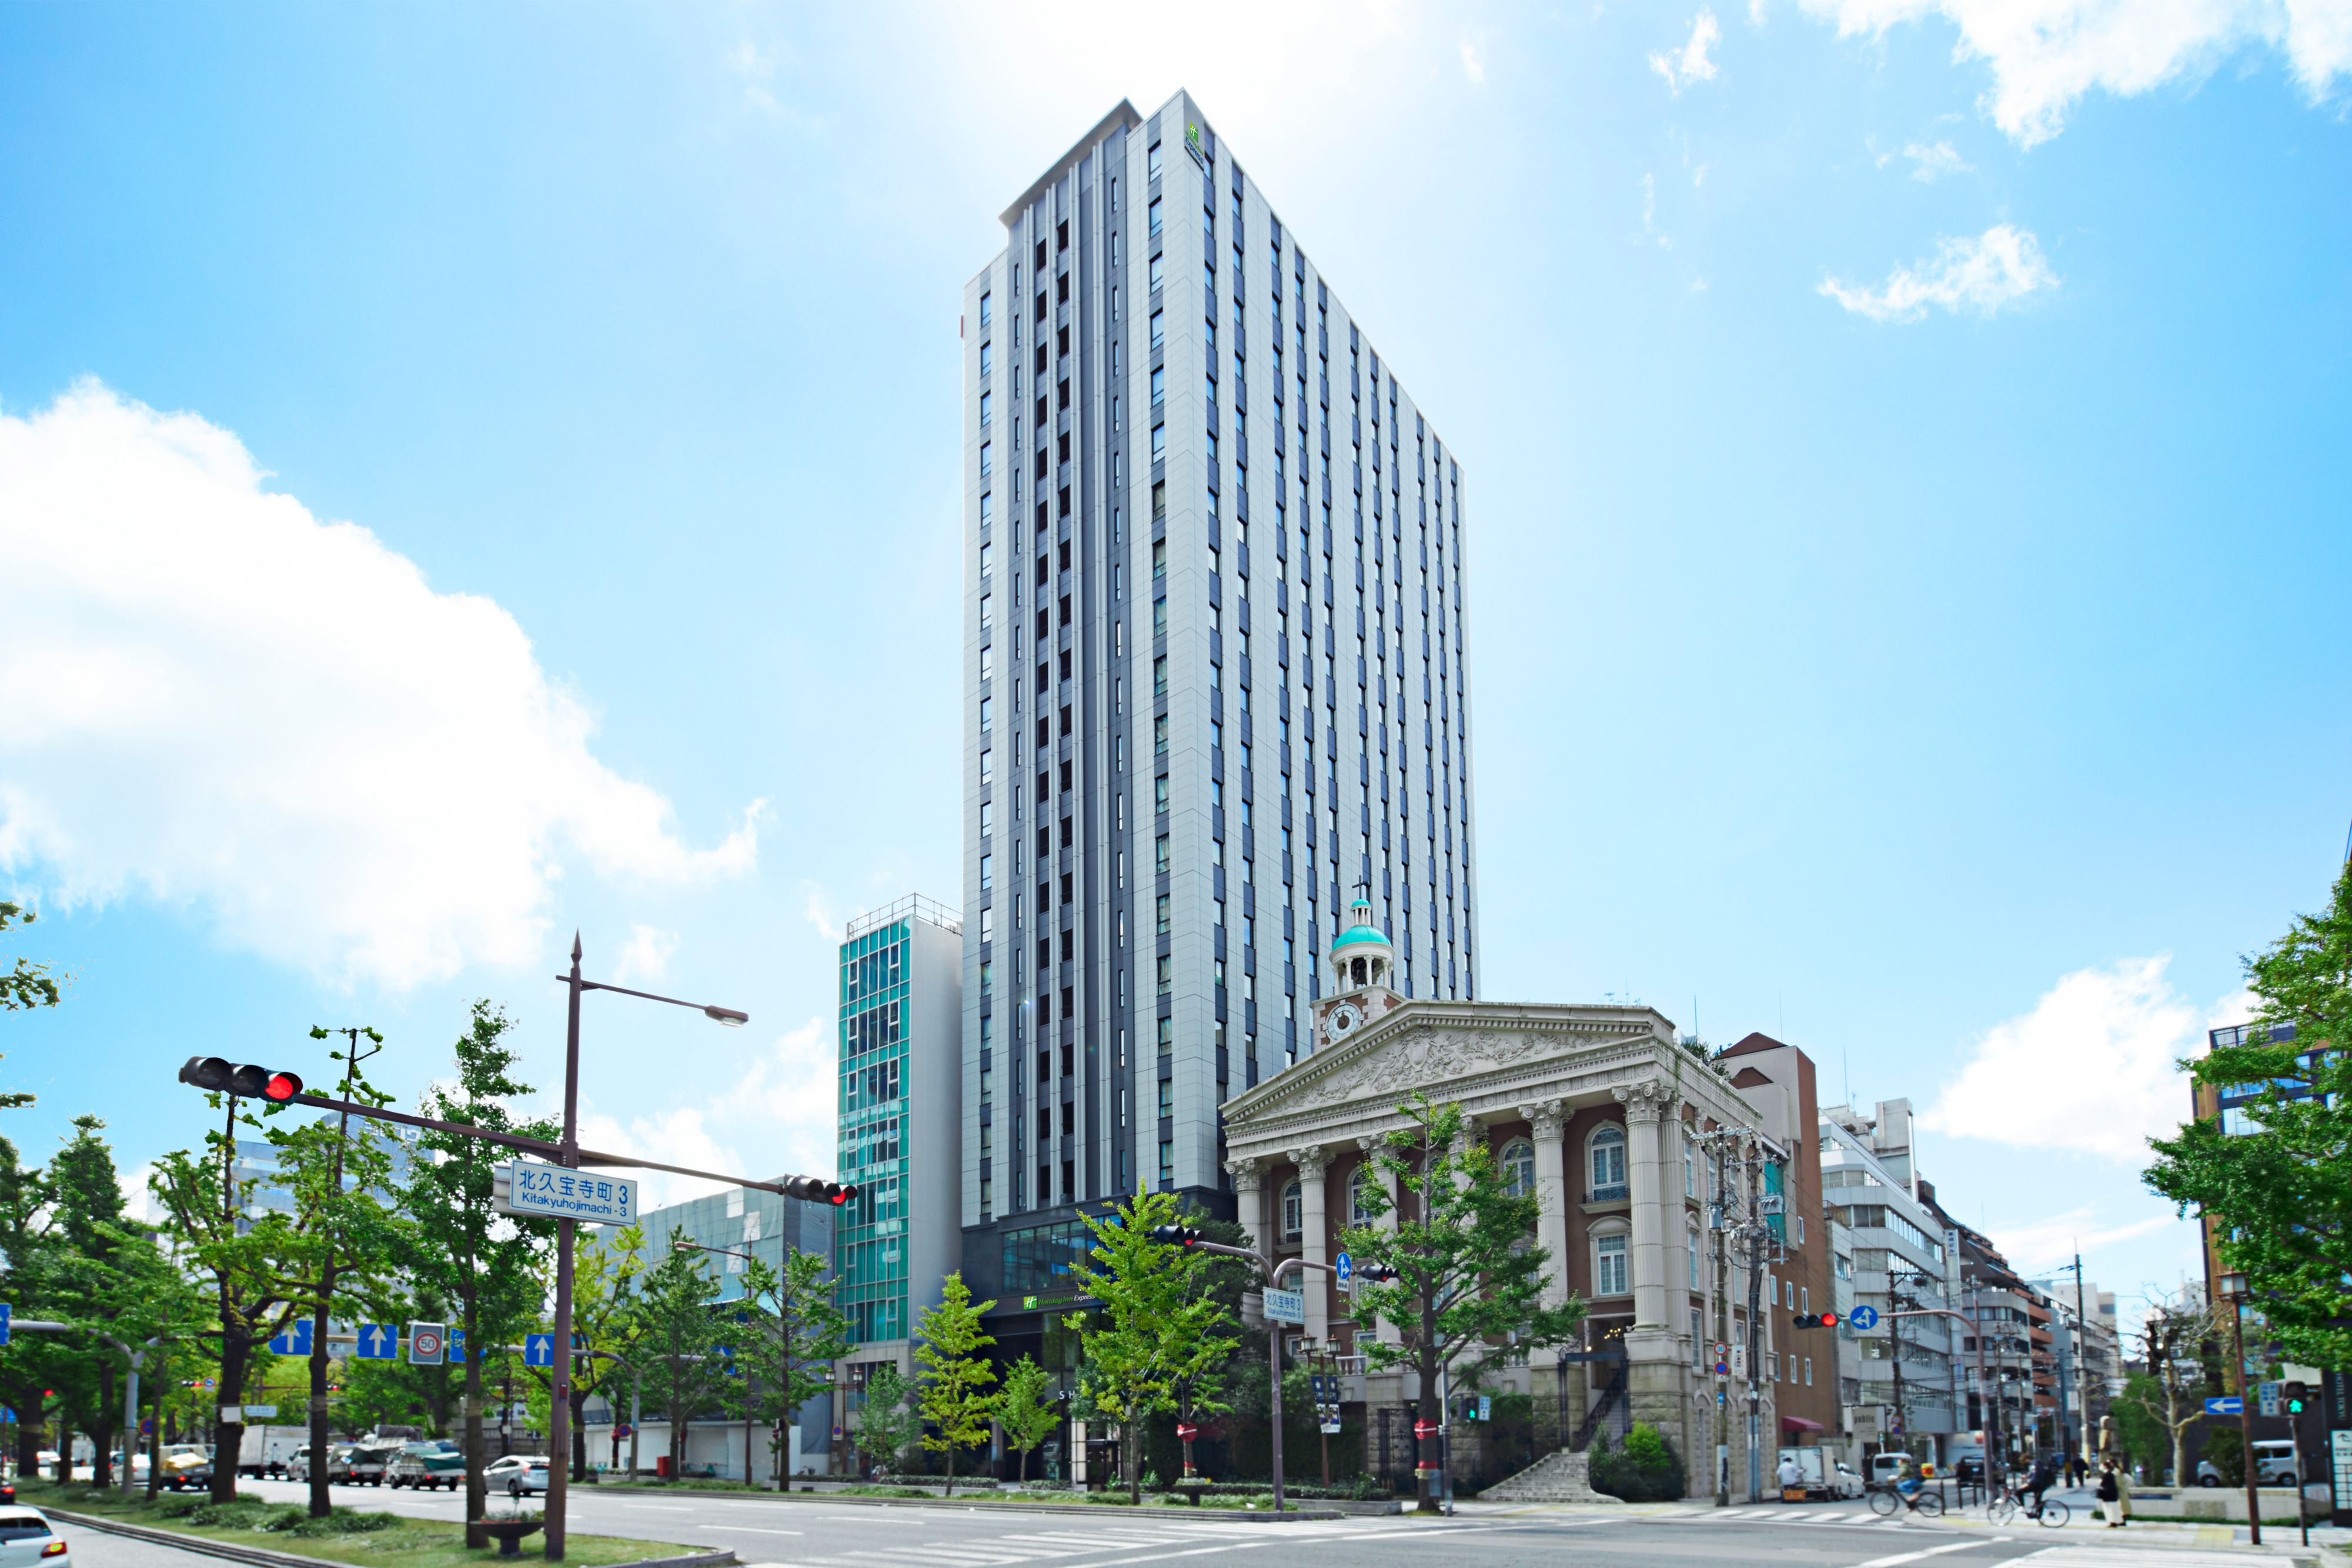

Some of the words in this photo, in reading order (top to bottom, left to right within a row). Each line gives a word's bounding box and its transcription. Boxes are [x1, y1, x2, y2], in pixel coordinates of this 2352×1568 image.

[1185, 136, 1204, 164] Express
[420, 1338, 435, 1349] 50
[1853, 1414, 1875, 1426] public
